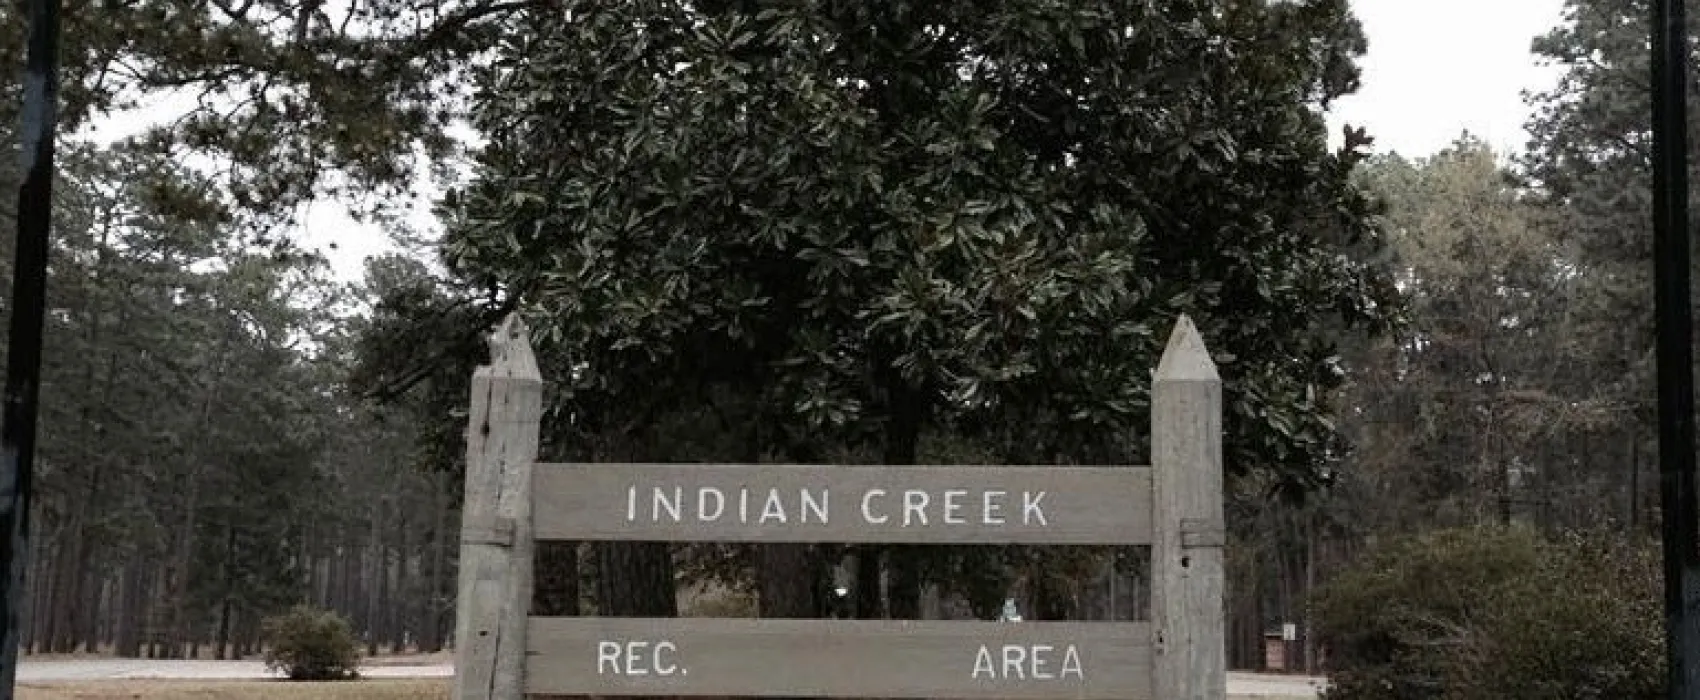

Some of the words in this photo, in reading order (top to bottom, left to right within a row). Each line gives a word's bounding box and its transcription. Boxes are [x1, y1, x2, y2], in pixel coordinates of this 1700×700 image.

[627, 485, 829, 524] INDIAN
[860, 488, 1049, 527] CREEK
[597, 641, 688, 676] REC.
[971, 644, 1084, 680] AREA
